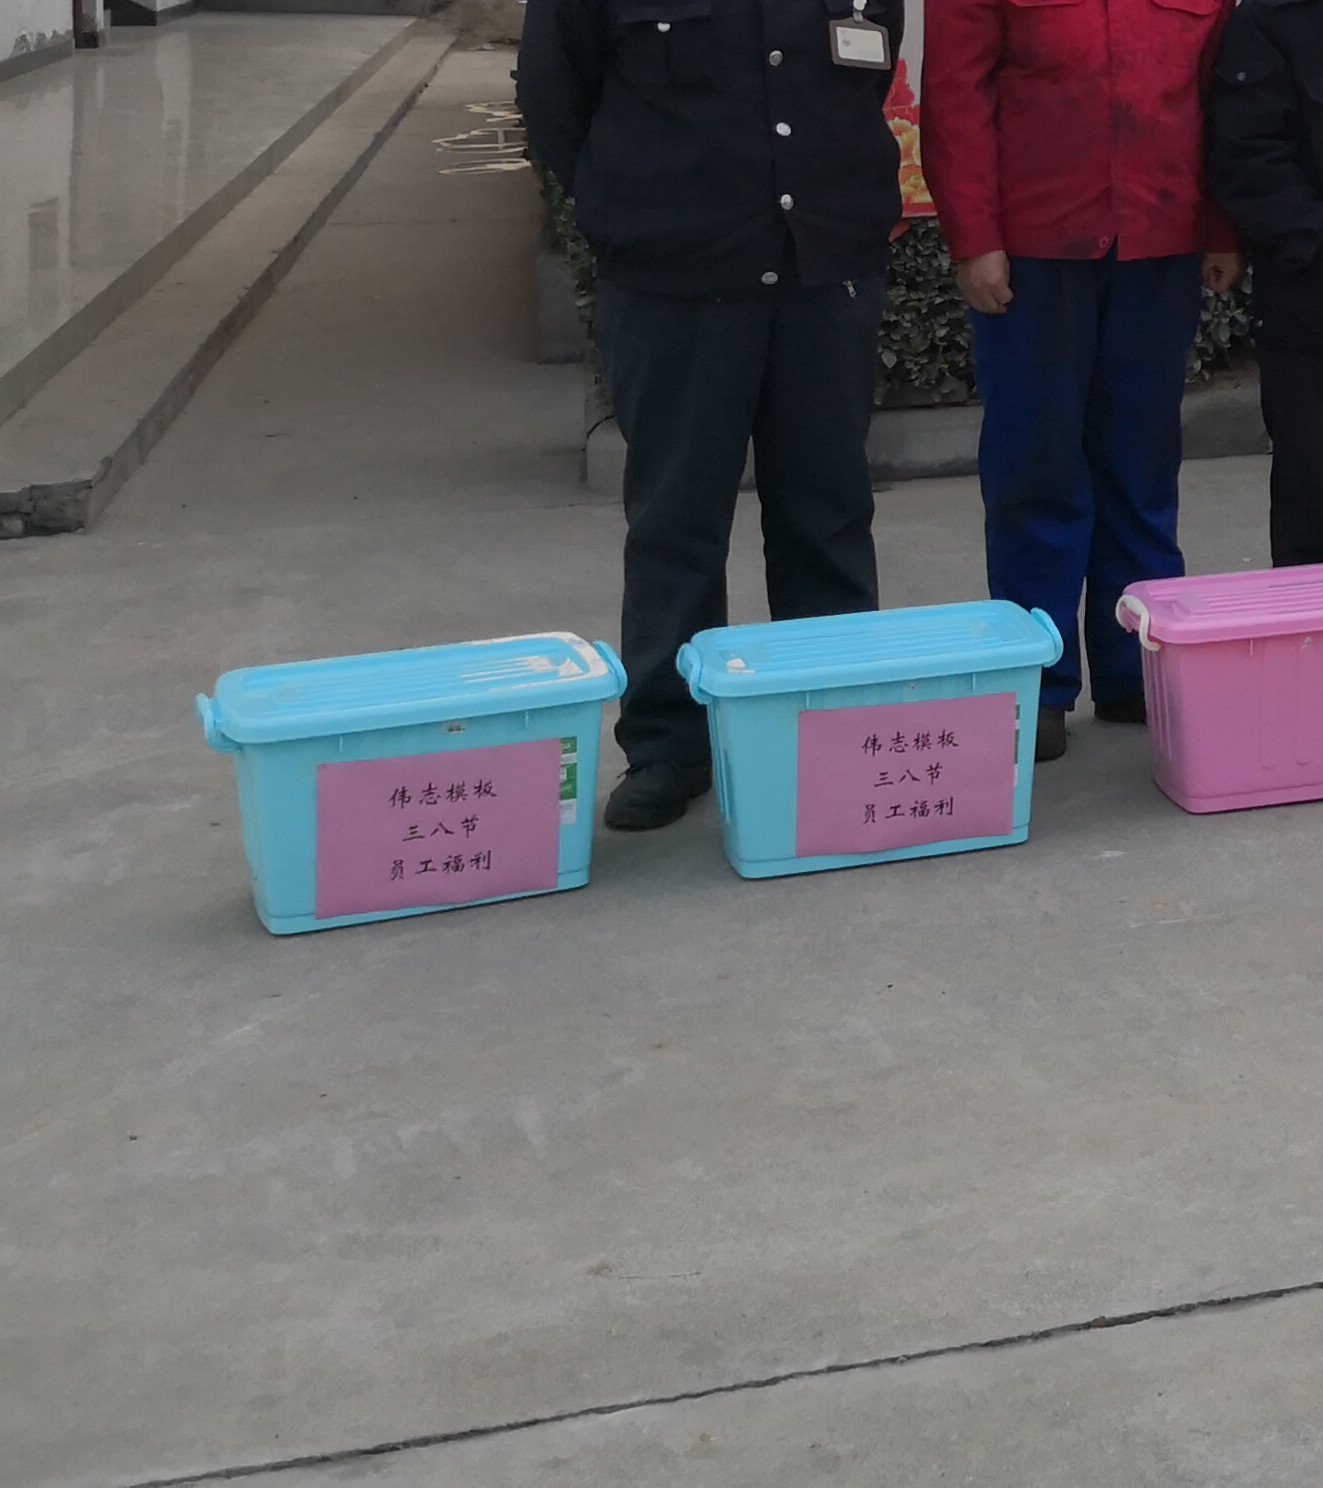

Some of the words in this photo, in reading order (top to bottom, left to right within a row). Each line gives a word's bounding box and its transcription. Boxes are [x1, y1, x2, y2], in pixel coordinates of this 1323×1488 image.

[861, 728, 960, 758] 伟志模板
[873, 762, 944, 788] 三八节
[389, 778, 498, 810] 伟志模板
[862, 796, 955, 824] 员工福利
[402, 814, 480, 843] 三八节
[389, 849, 493, 881] 员工福利
